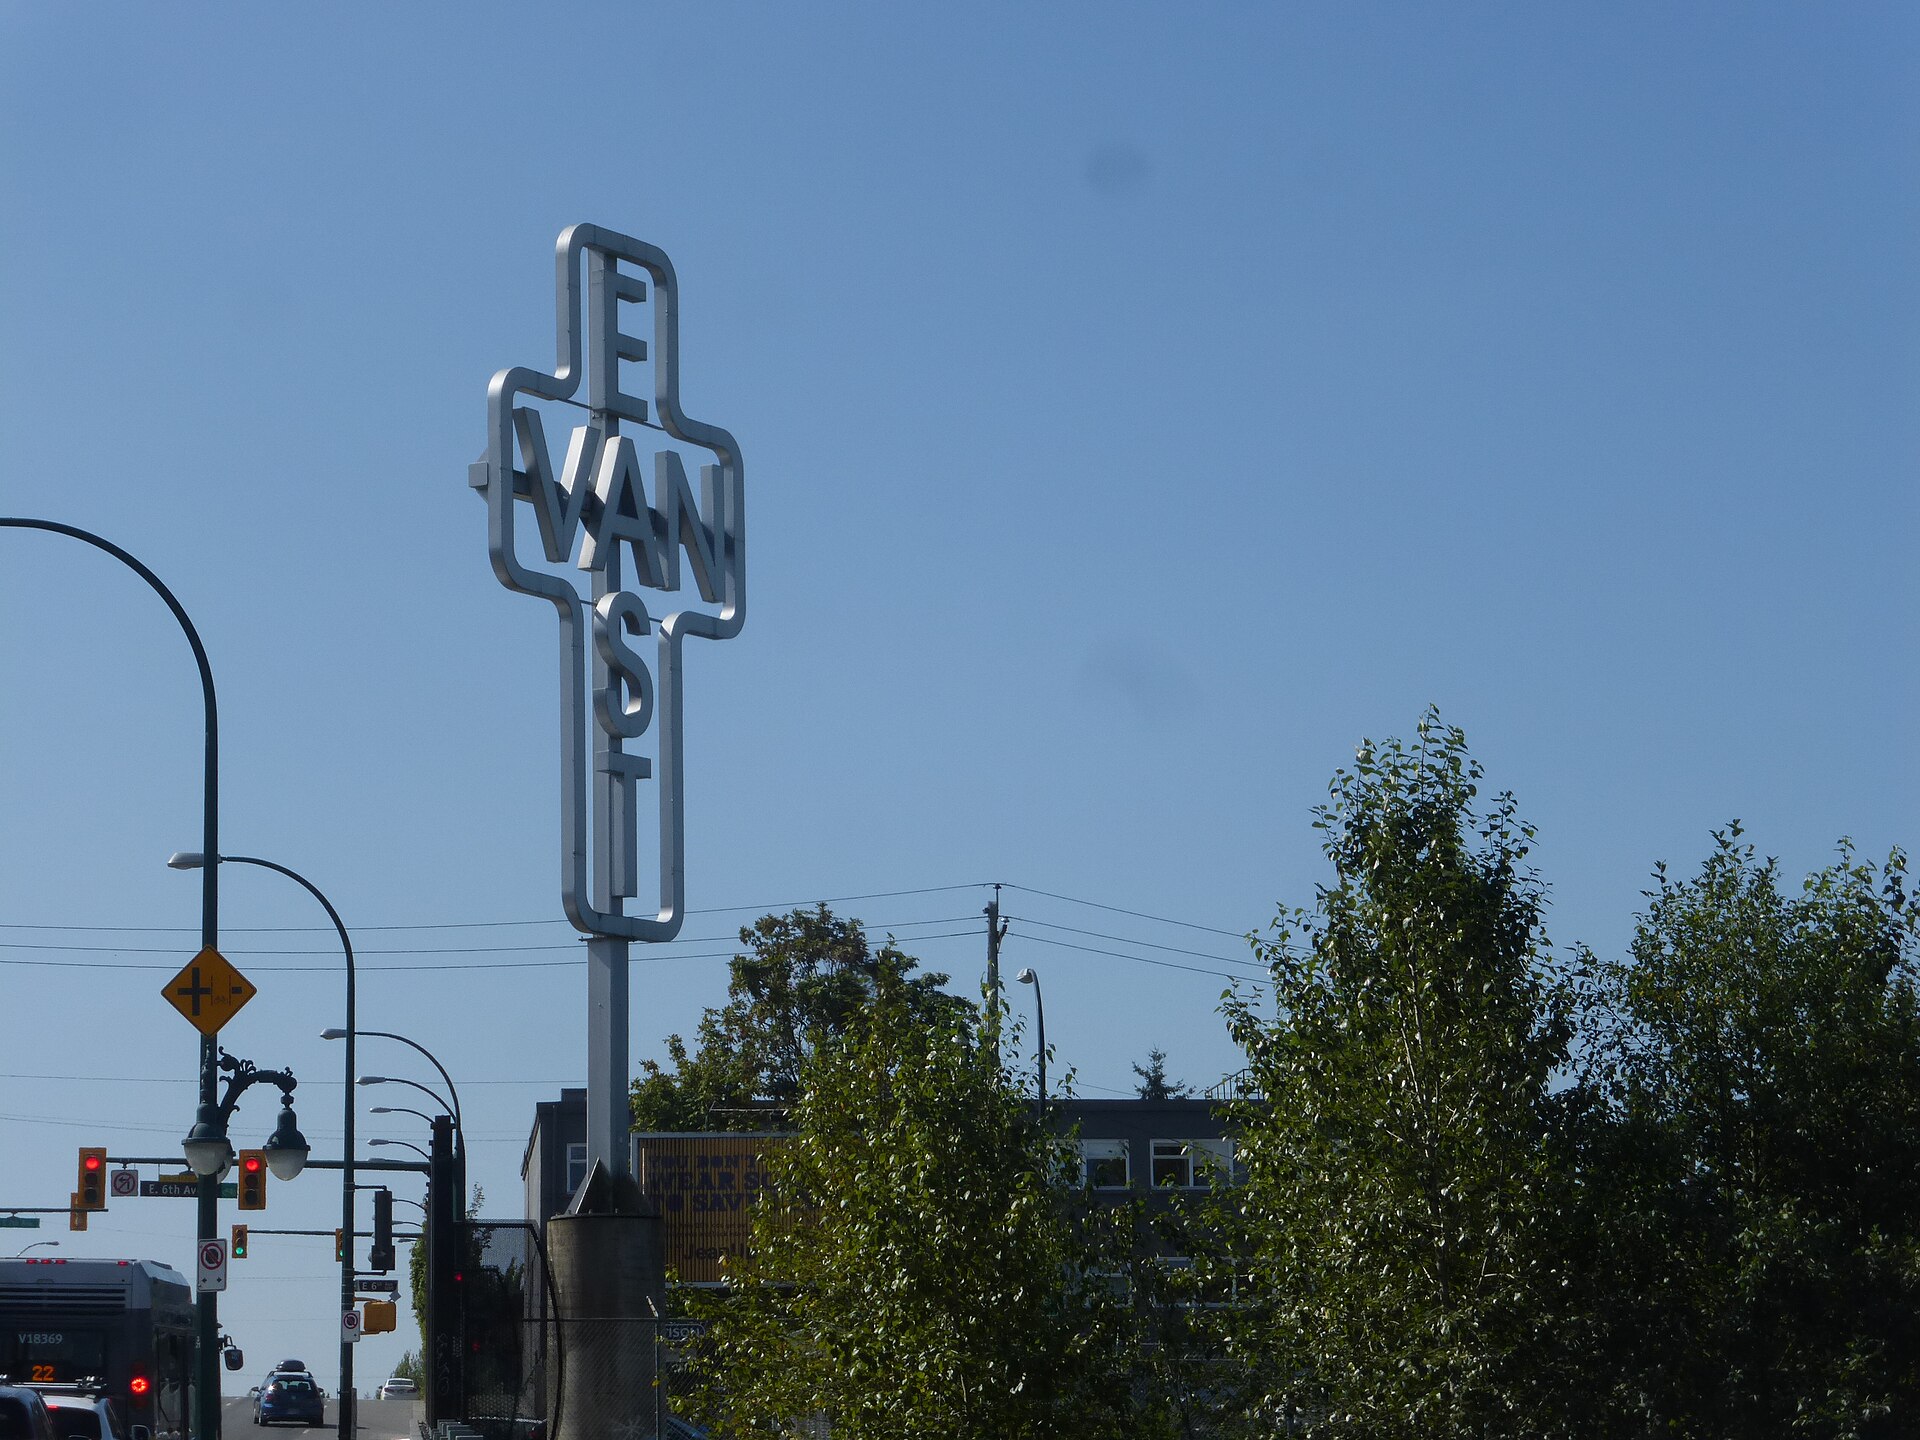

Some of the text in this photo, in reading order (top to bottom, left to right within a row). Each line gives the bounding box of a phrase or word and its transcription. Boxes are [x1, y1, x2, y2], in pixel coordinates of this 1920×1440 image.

[162, 1184, 180, 1194] 6th
[183, 1185, 199, 1194] Av
[648, 1172, 735, 1189] WEAR
[649, 1194, 684, 1212] TO
[18, 1333, 63, 1344] V18369
[32, 1364, 55, 1381] 22
